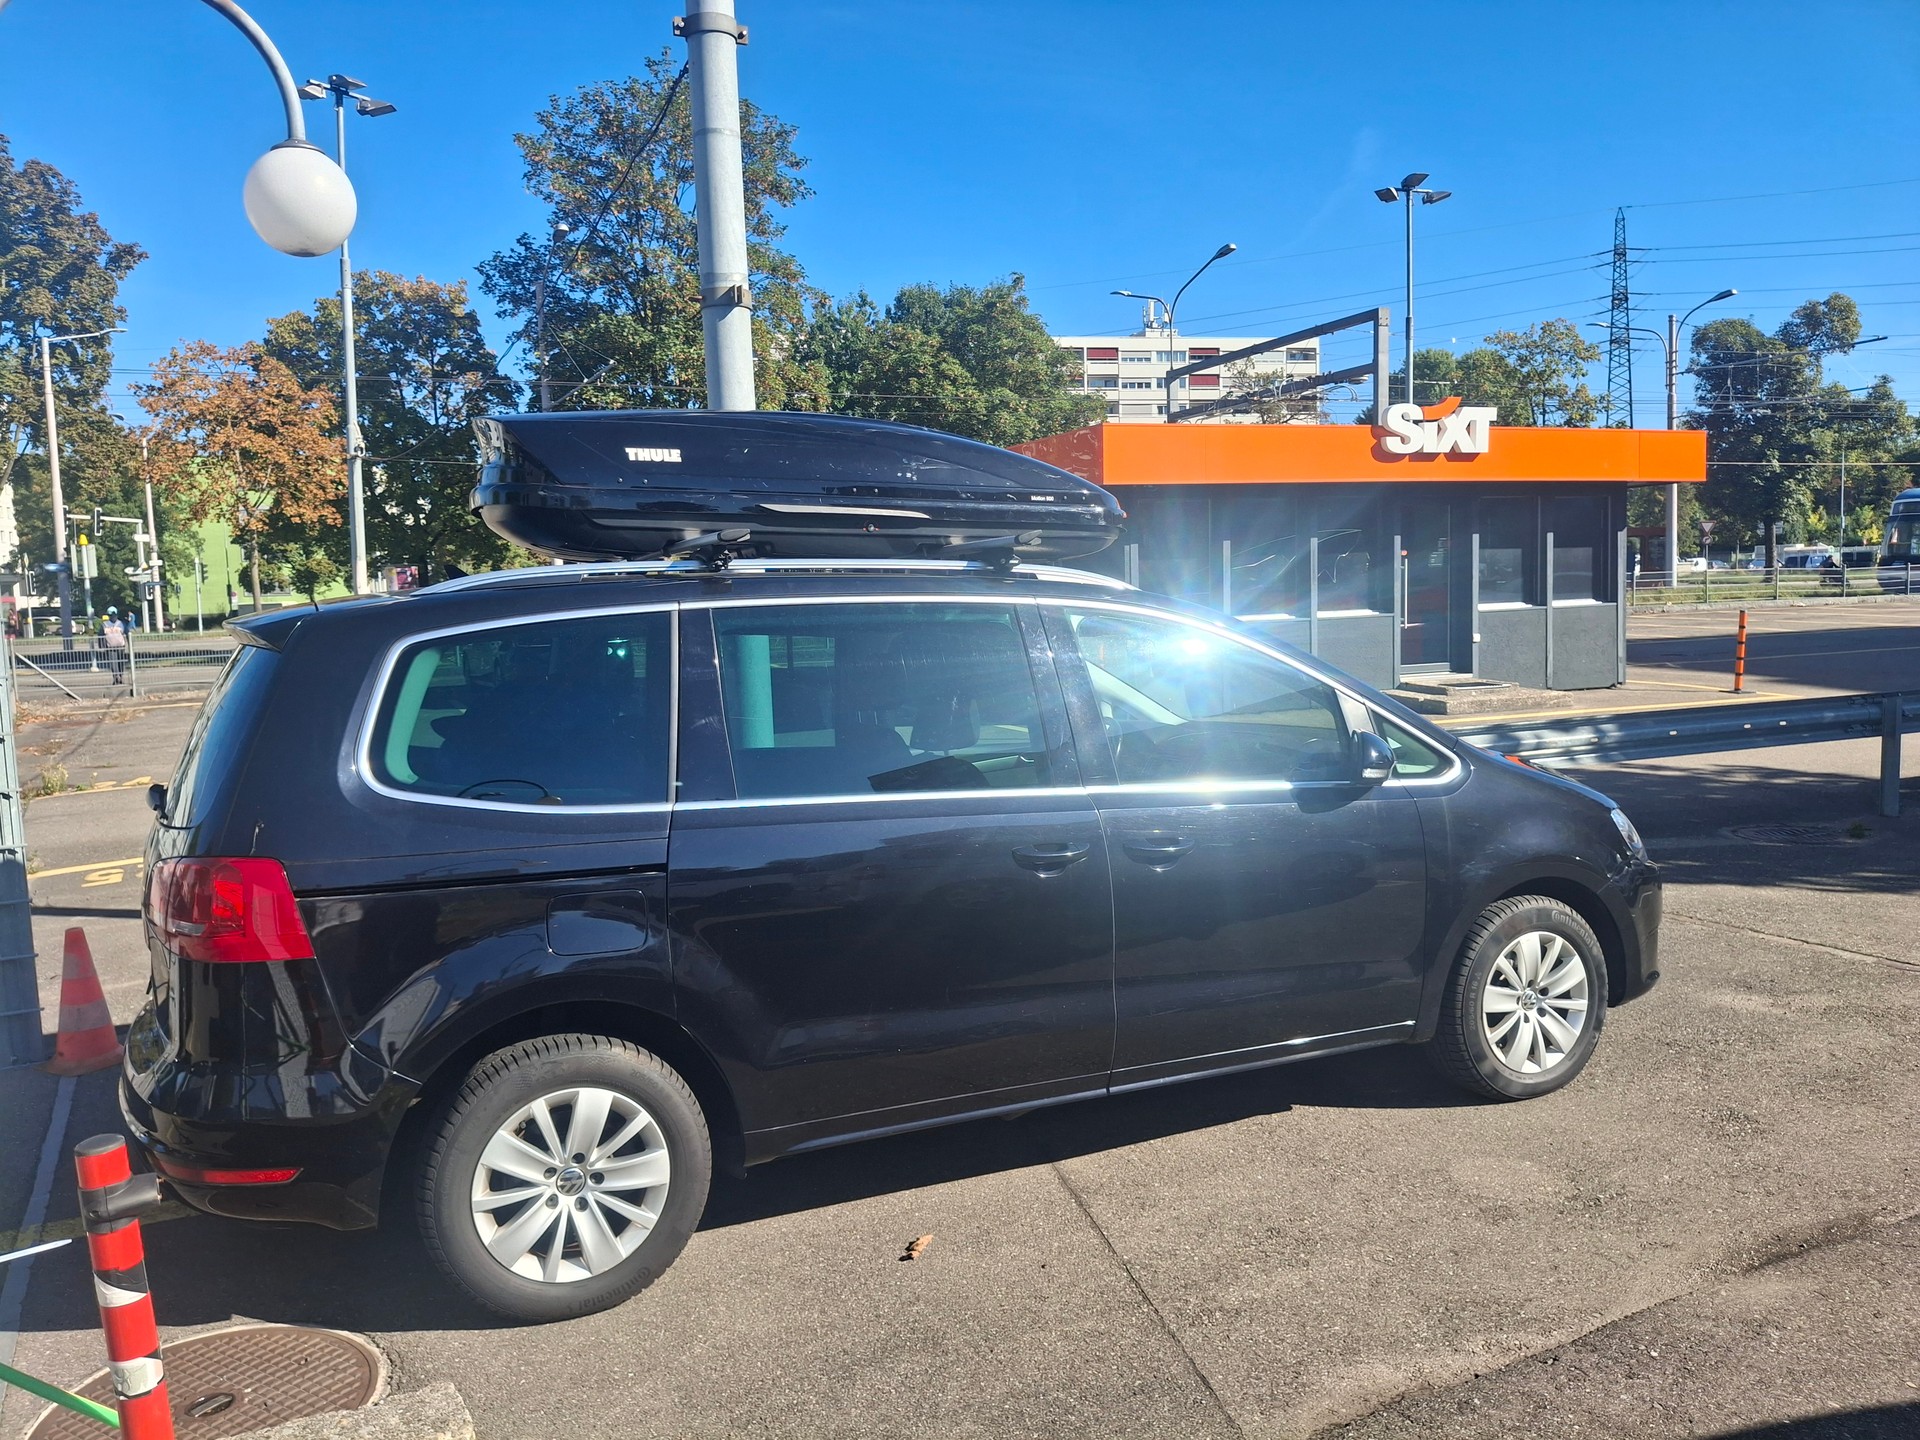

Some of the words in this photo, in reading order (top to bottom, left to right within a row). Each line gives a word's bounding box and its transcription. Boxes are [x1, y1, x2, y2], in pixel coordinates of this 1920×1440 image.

[624, 447, 682, 462] THULE
[1551, 910, 1594, 948] Continental
[578, 1266, 652, 1311] Continental
